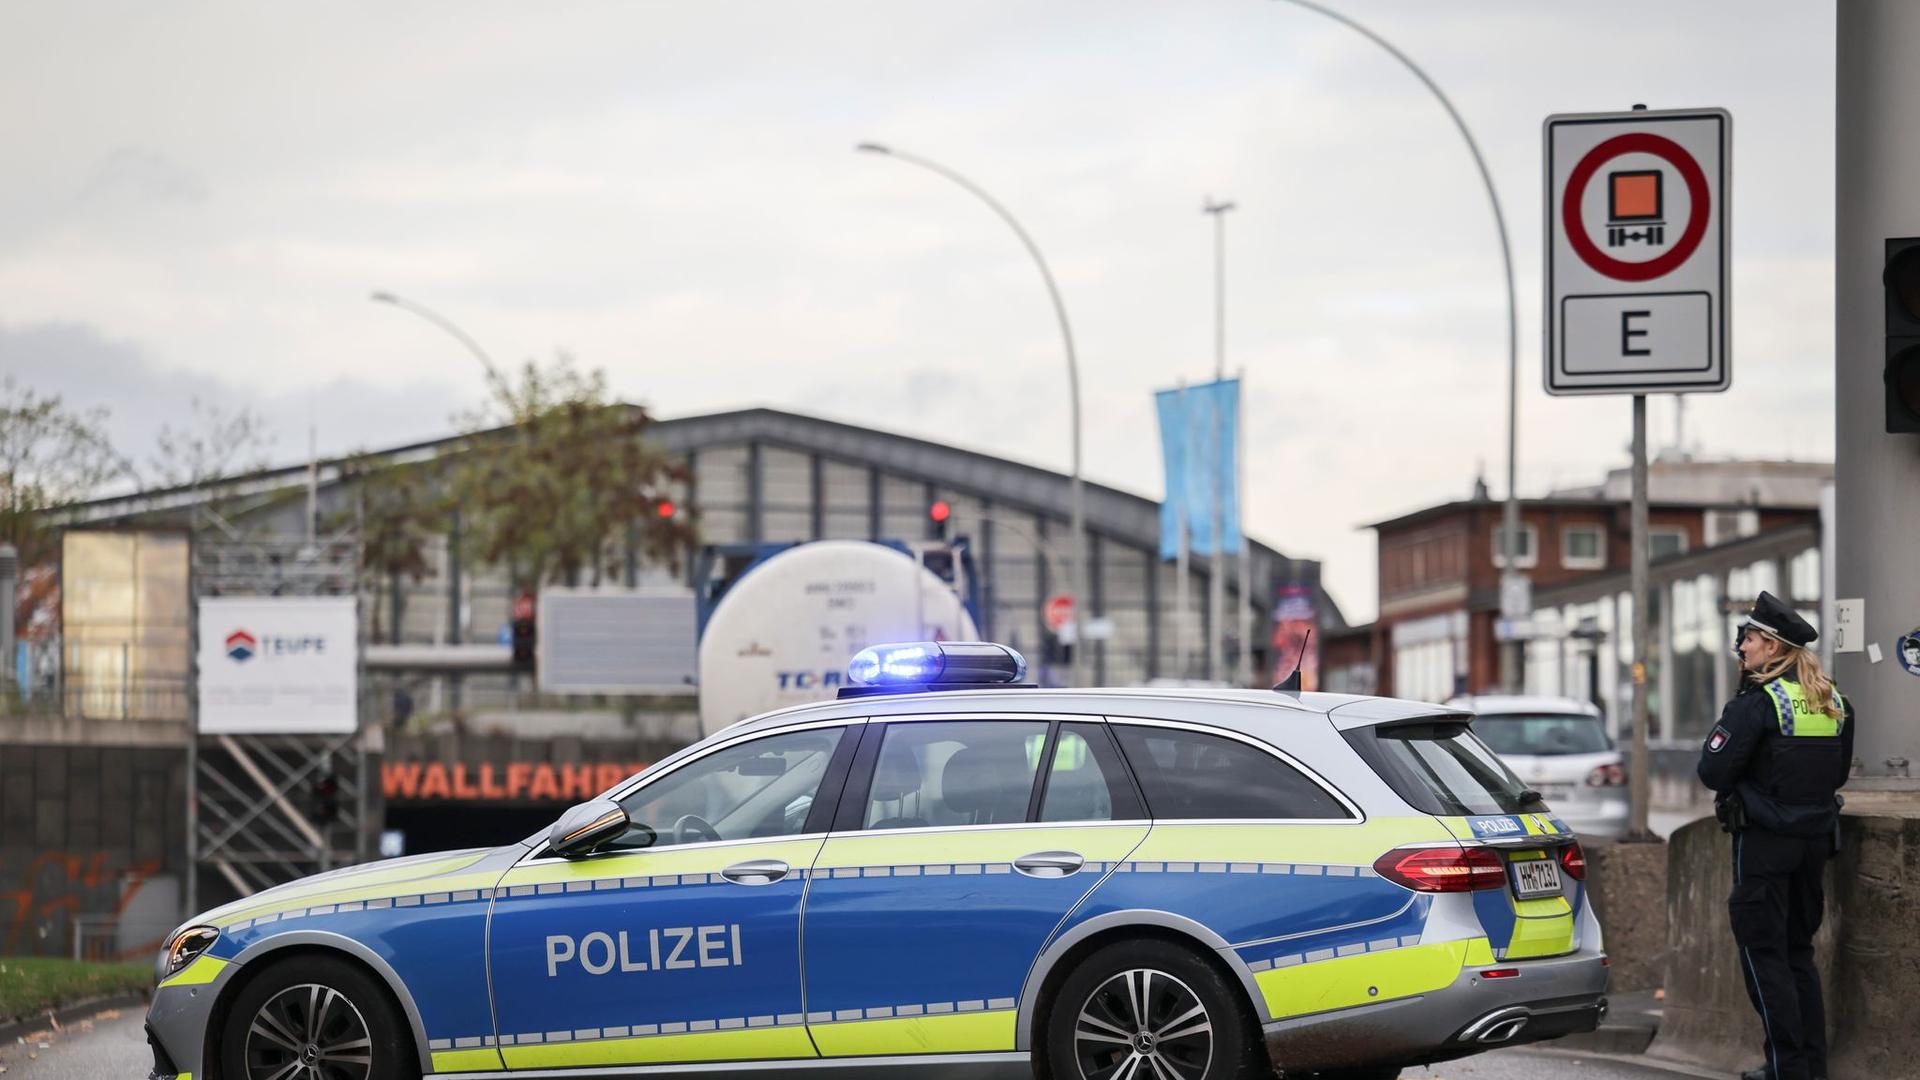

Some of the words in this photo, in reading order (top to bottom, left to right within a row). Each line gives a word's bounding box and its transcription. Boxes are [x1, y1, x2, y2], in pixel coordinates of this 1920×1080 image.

[1621, 310, 1651, 356] E
[1476, 818, 1520, 834] POLIZEI
[546, 924, 742, 977] POLIZEI
